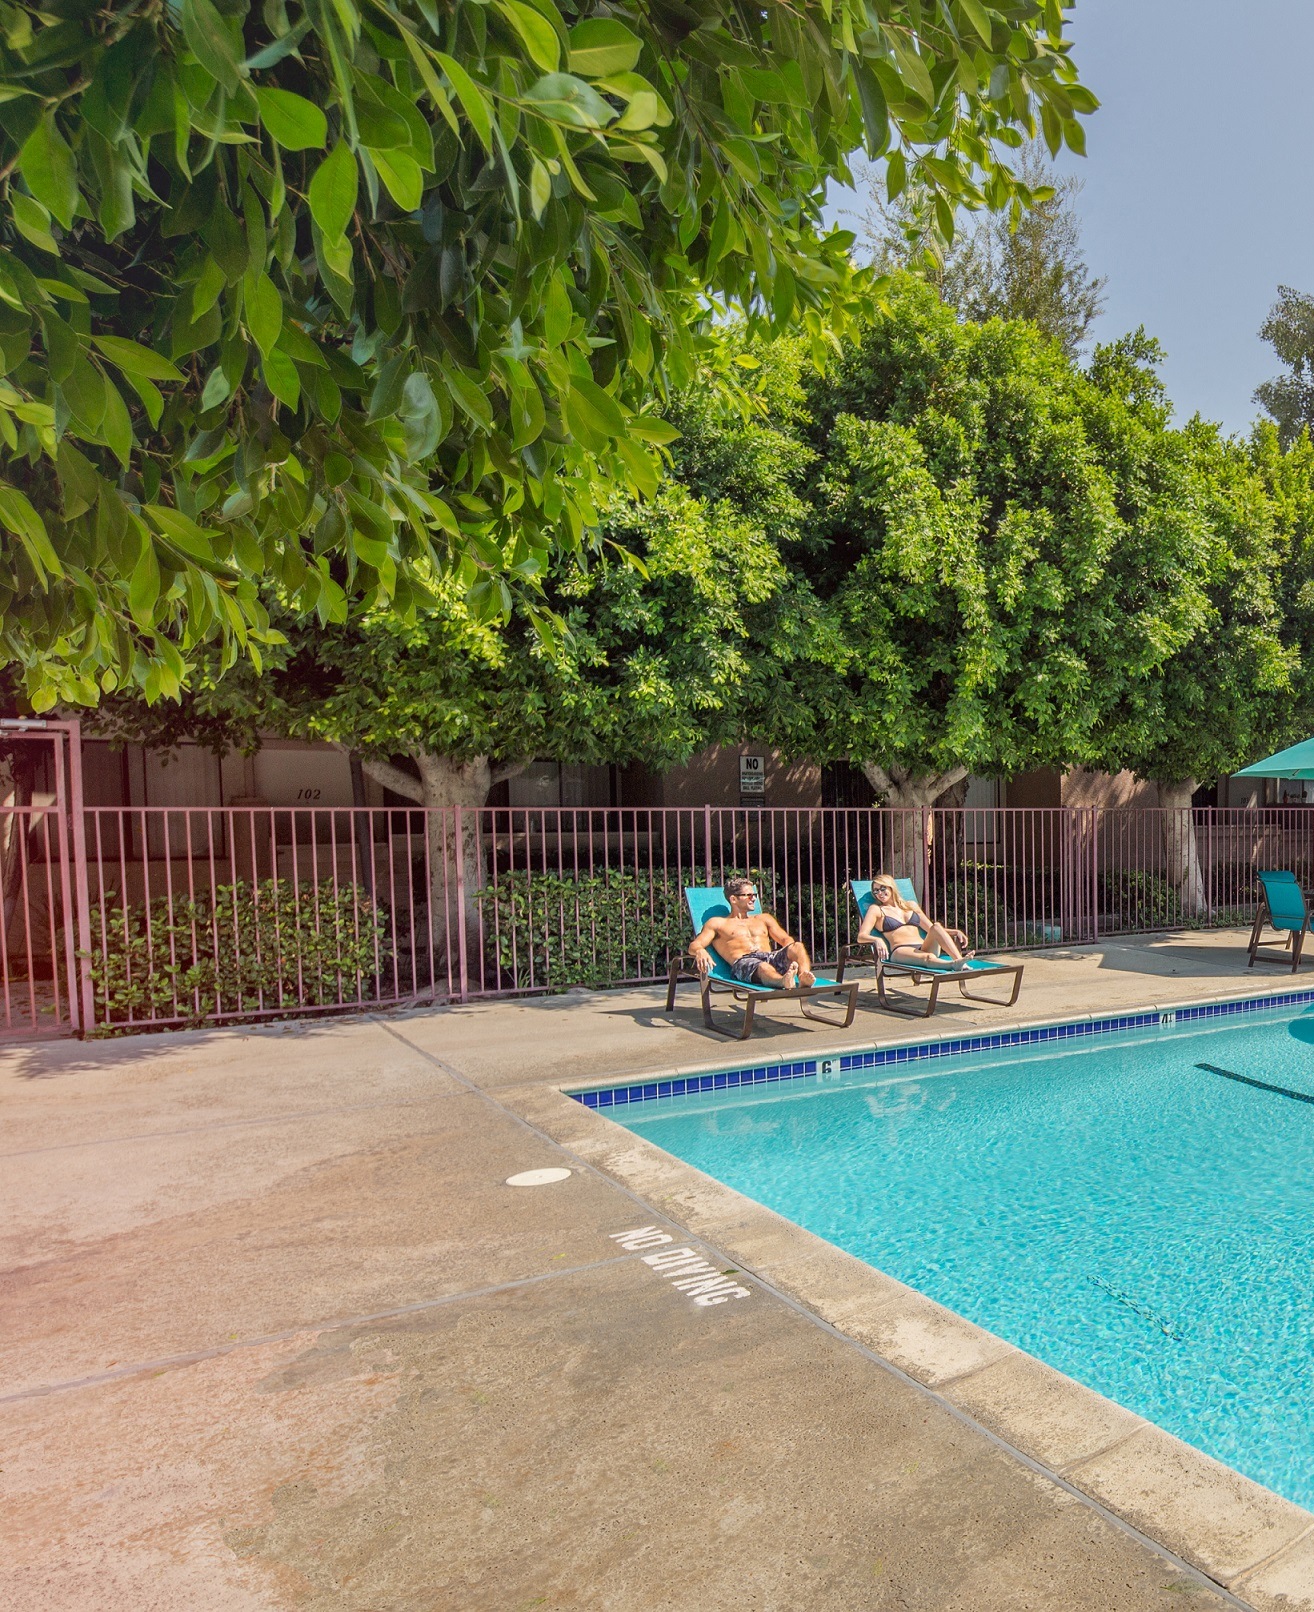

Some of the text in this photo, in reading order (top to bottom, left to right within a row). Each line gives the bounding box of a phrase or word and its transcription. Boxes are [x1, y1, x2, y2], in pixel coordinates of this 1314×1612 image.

[746, 758, 759, 770] NO
[297, 789, 321, 799] 102
[609, 1225, 751, 1307] NO DIVING
